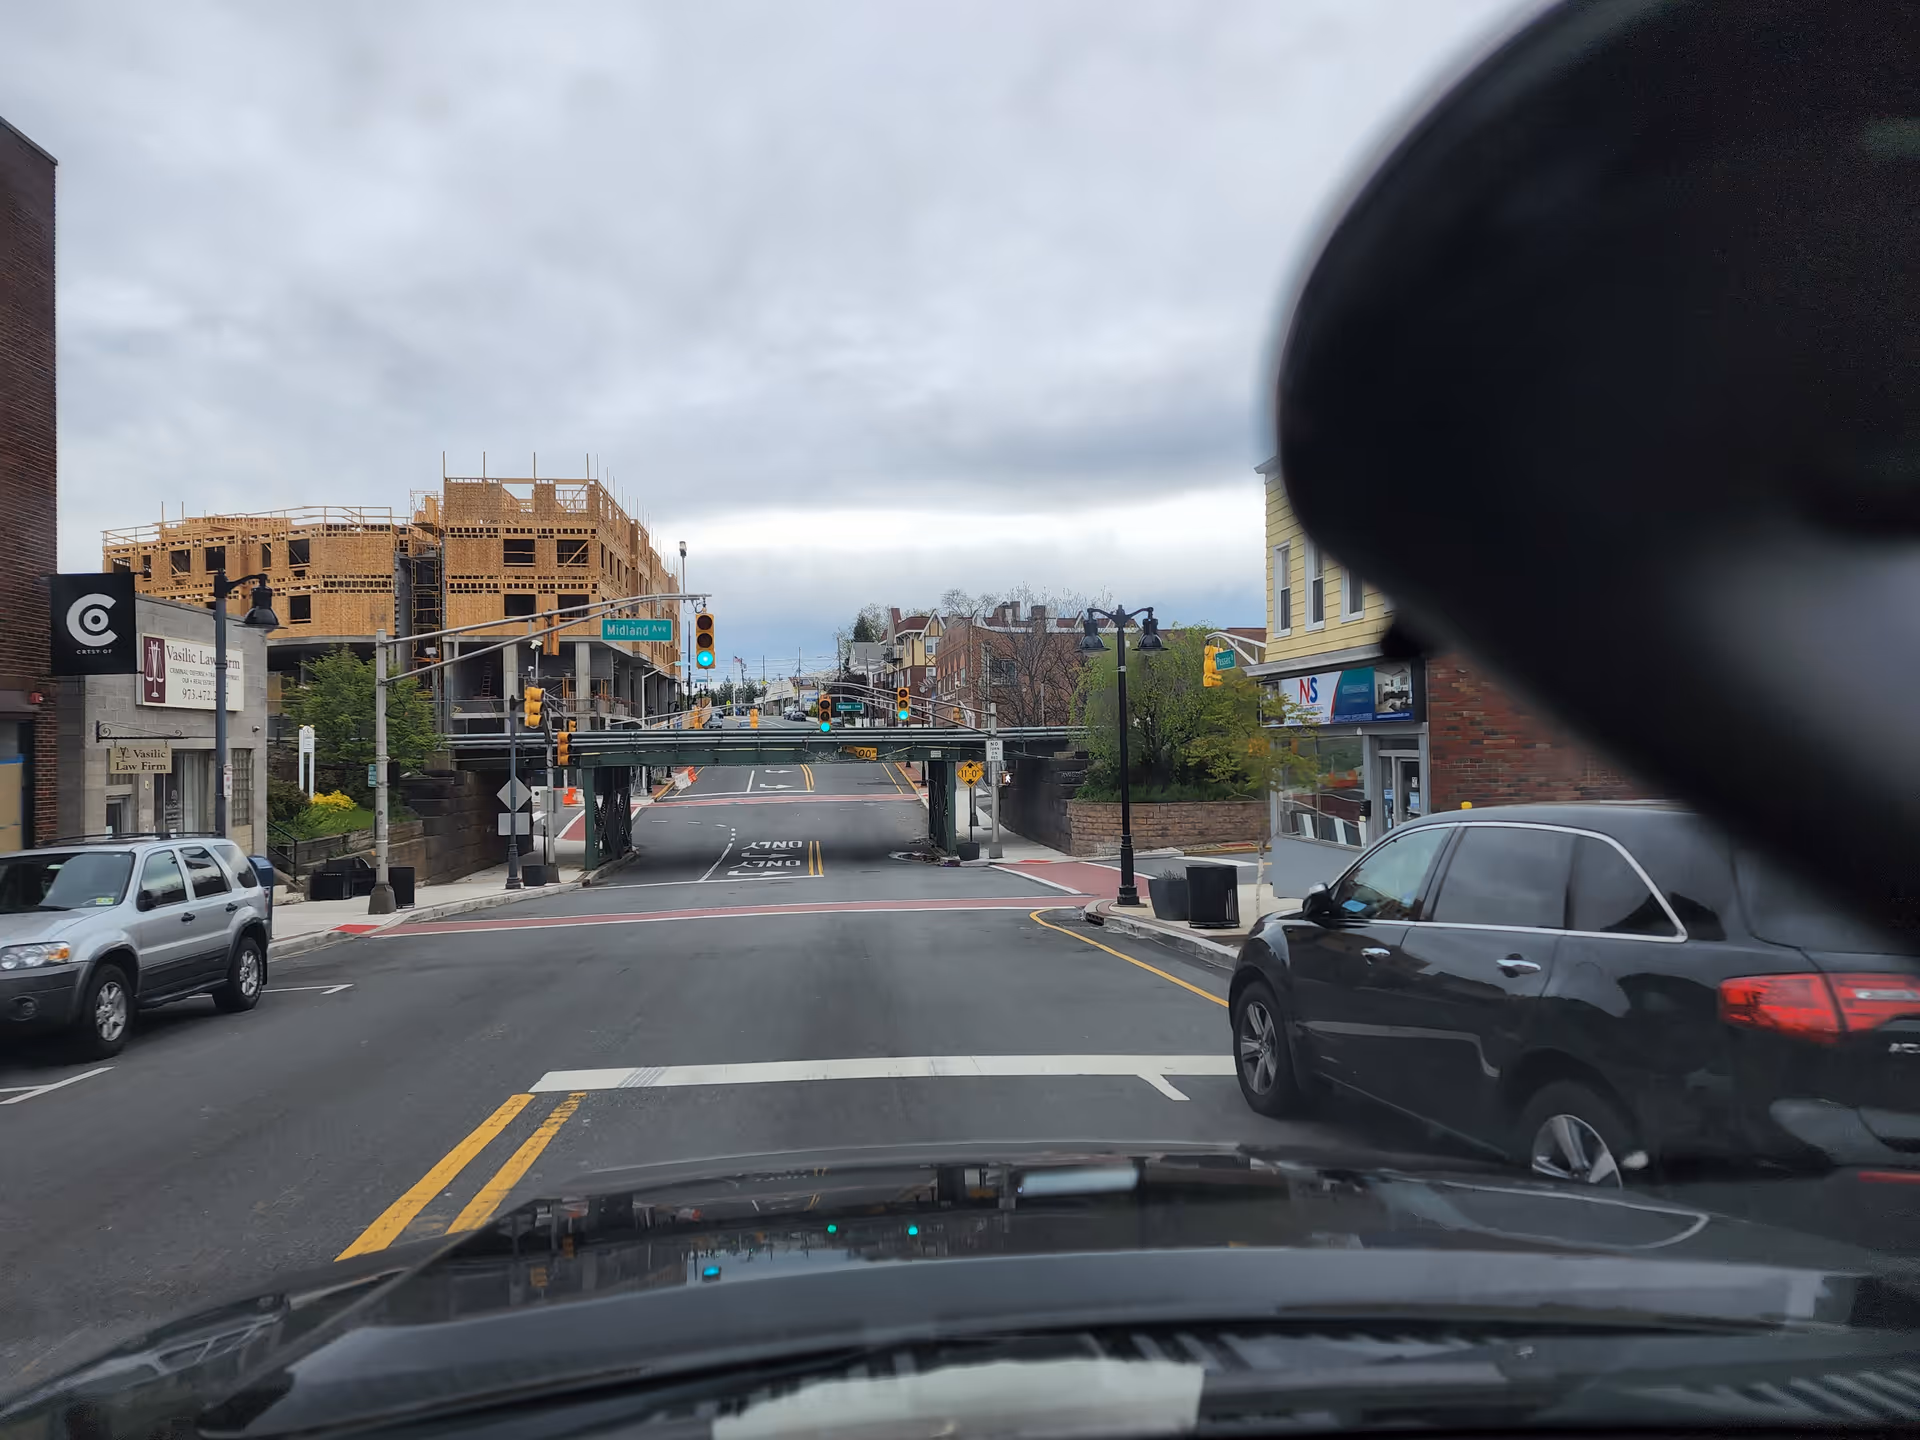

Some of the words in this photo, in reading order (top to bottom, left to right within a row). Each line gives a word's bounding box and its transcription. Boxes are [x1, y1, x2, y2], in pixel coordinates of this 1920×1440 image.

[607, 624, 649, 636] Midland
[652, 625, 667, 633] Ave
[166, 645, 196, 663] Vasilic
[1299, 677, 1318, 704] NS
[133, 749, 166, 758] Vasilic
[115, 761, 137, 770] Law
[141, 761, 166, 770] Firm
[741, 840, 803, 850] ONLY
[729, 860, 801, 869] ONLY
